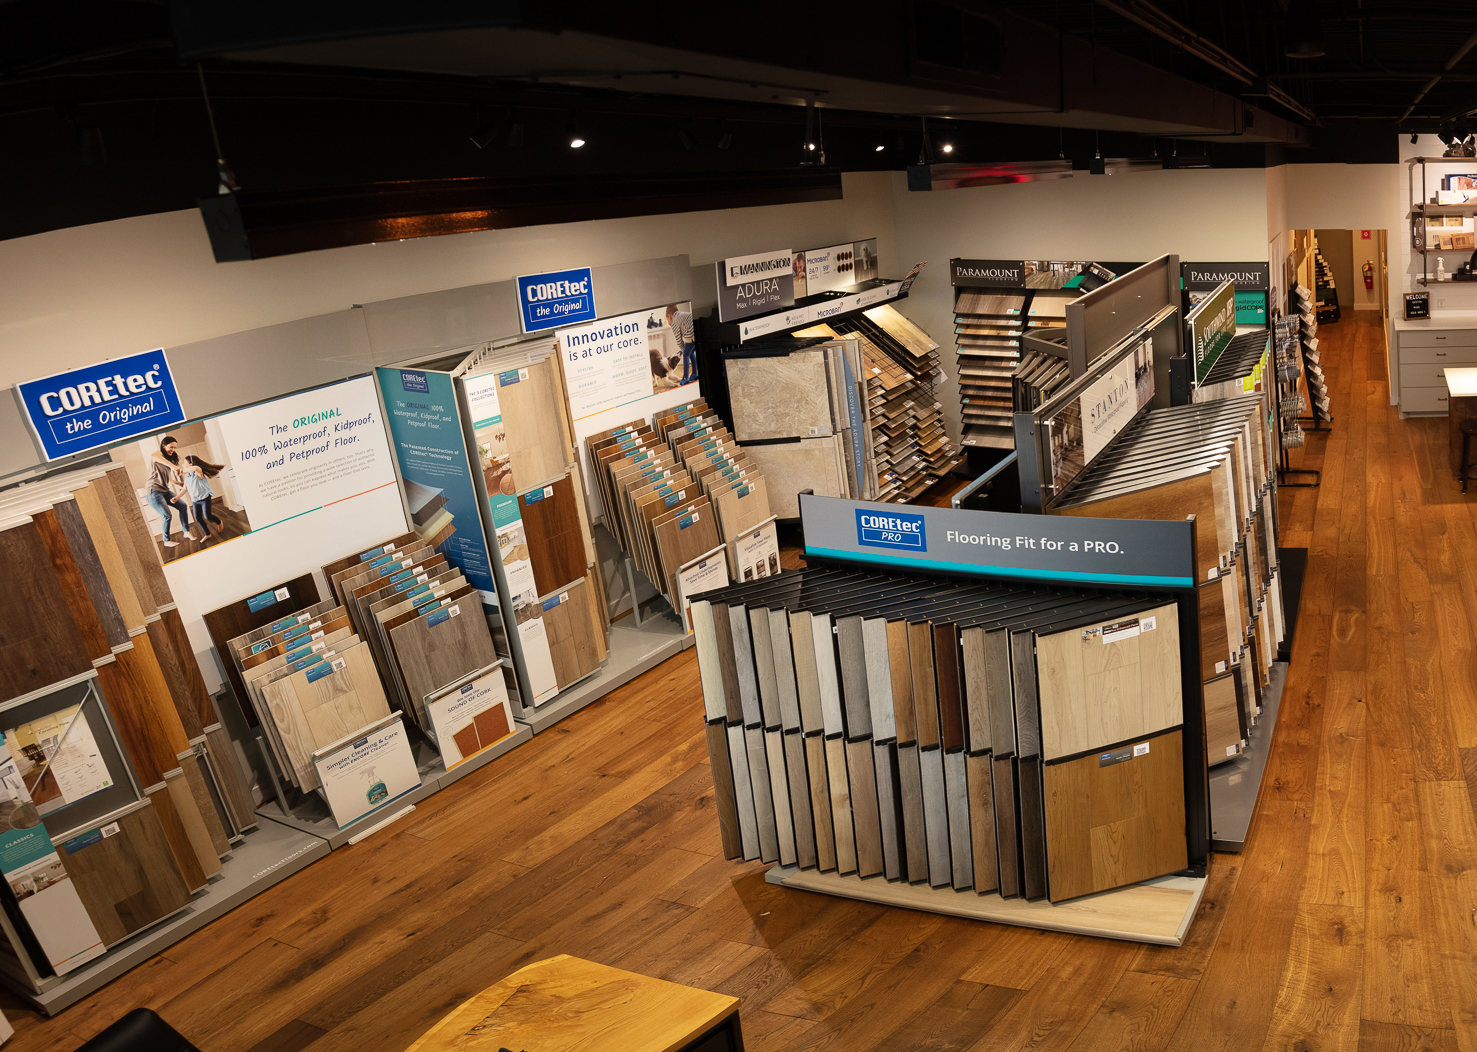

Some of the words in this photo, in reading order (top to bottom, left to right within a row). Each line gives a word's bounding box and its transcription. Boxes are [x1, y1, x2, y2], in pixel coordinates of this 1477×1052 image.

[740, 257, 791, 275] MANNINGTON
[956, 267, 1019, 278] PARAMOUNT
[1191, 271, 1261, 281] PARAMOUNT
[736, 279, 779, 300] ADURA
[536, 306, 550, 317] the
[553, 299, 582, 316] Original
[753, 298, 766, 306] Rigid
[567, 321, 640, 348] Innovation
[568, 350, 578, 361] is
[581, 347, 592, 358] at
[596, 342, 614, 355] our
[617, 336, 642, 350] core.
[578, 380, 597, 389] DURABLE
[396, 400, 405, 408] The
[406, 402, 429, 410] ORIGINAL
[1091, 378, 1129, 424] STANTON
[65, 418, 92, 434] the
[99, 397, 154, 425] Original
[269, 424, 288, 436] The
[292, 407, 342, 429] ORIGINAL
[393, 409, 420, 419] Waterproof,
[420, 411, 441, 422] Kidproof,
[407, 419, 426, 428] Petproof
[428, 421, 441, 429] Floor.
[241, 445, 268, 461] 100%
[273, 426, 331, 451] Waterproof,
[334, 412, 375, 433] Kidproof,
[266, 455, 285, 470] and
[289, 441, 330, 462] Petproof
[334, 435, 360, 448] Floor.
[428, 453, 452, 461] Technology
[881, 531, 902, 541] PRO
[946, 530, 1012, 550] Flooring
[1016, 536, 1036, 549] Fit
[1040, 537, 1065, 551] for
[1069, 541, 1079, 552] a
[1084, 540, 1125, 554] PRO.
[447, 700, 468, 713] SOUND
[476, 688, 491, 698] CORK
[38, 725, 58, 734] Carolina
[326, 756, 350, 770] Simpler
[351, 742, 377, 758] Cleaning
[384, 731, 398, 741] Care
[339, 762, 350, 770] with
[350, 751, 369, 764] ENCORE
[370, 742, 389, 753] Cleaner
[5, 833, 34, 848] CLASSICS
[252, 840, 318, 879] COREtecFloors.com
